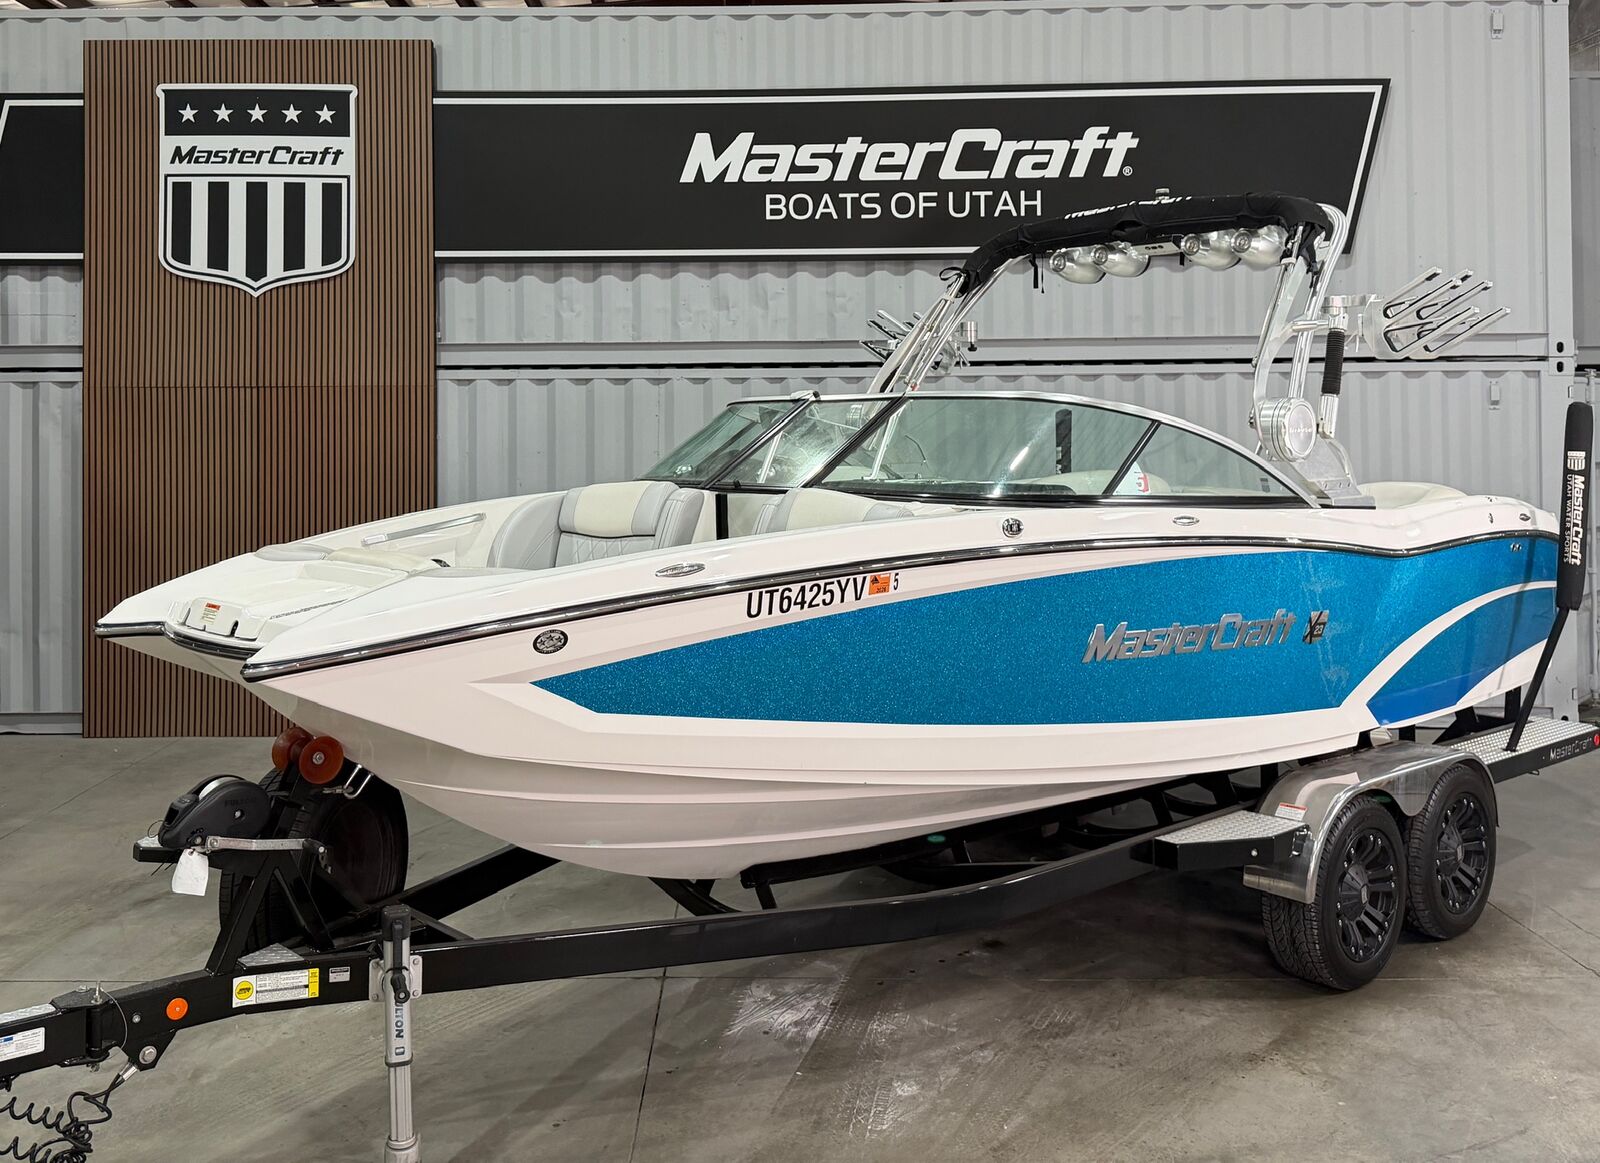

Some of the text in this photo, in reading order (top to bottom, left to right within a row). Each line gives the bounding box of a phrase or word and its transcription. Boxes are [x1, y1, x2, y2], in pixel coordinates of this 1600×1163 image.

[170, 145, 344, 166] MasterCraft
[765, 192, 881, 220] BOATS
[890, 192, 938, 219] OF
[947, 190, 1042, 217] UTAH
[1571, 474, 1585, 566] MasterCraft
[1563, 530, 1571, 563] SPORTS
[746, 576, 867, 618] UT6425YV
[893, 572, 900, 591] 5
[1082, 608, 1297, 663] MasterCraft
[394, 1000, 404, 1039] ULTON
